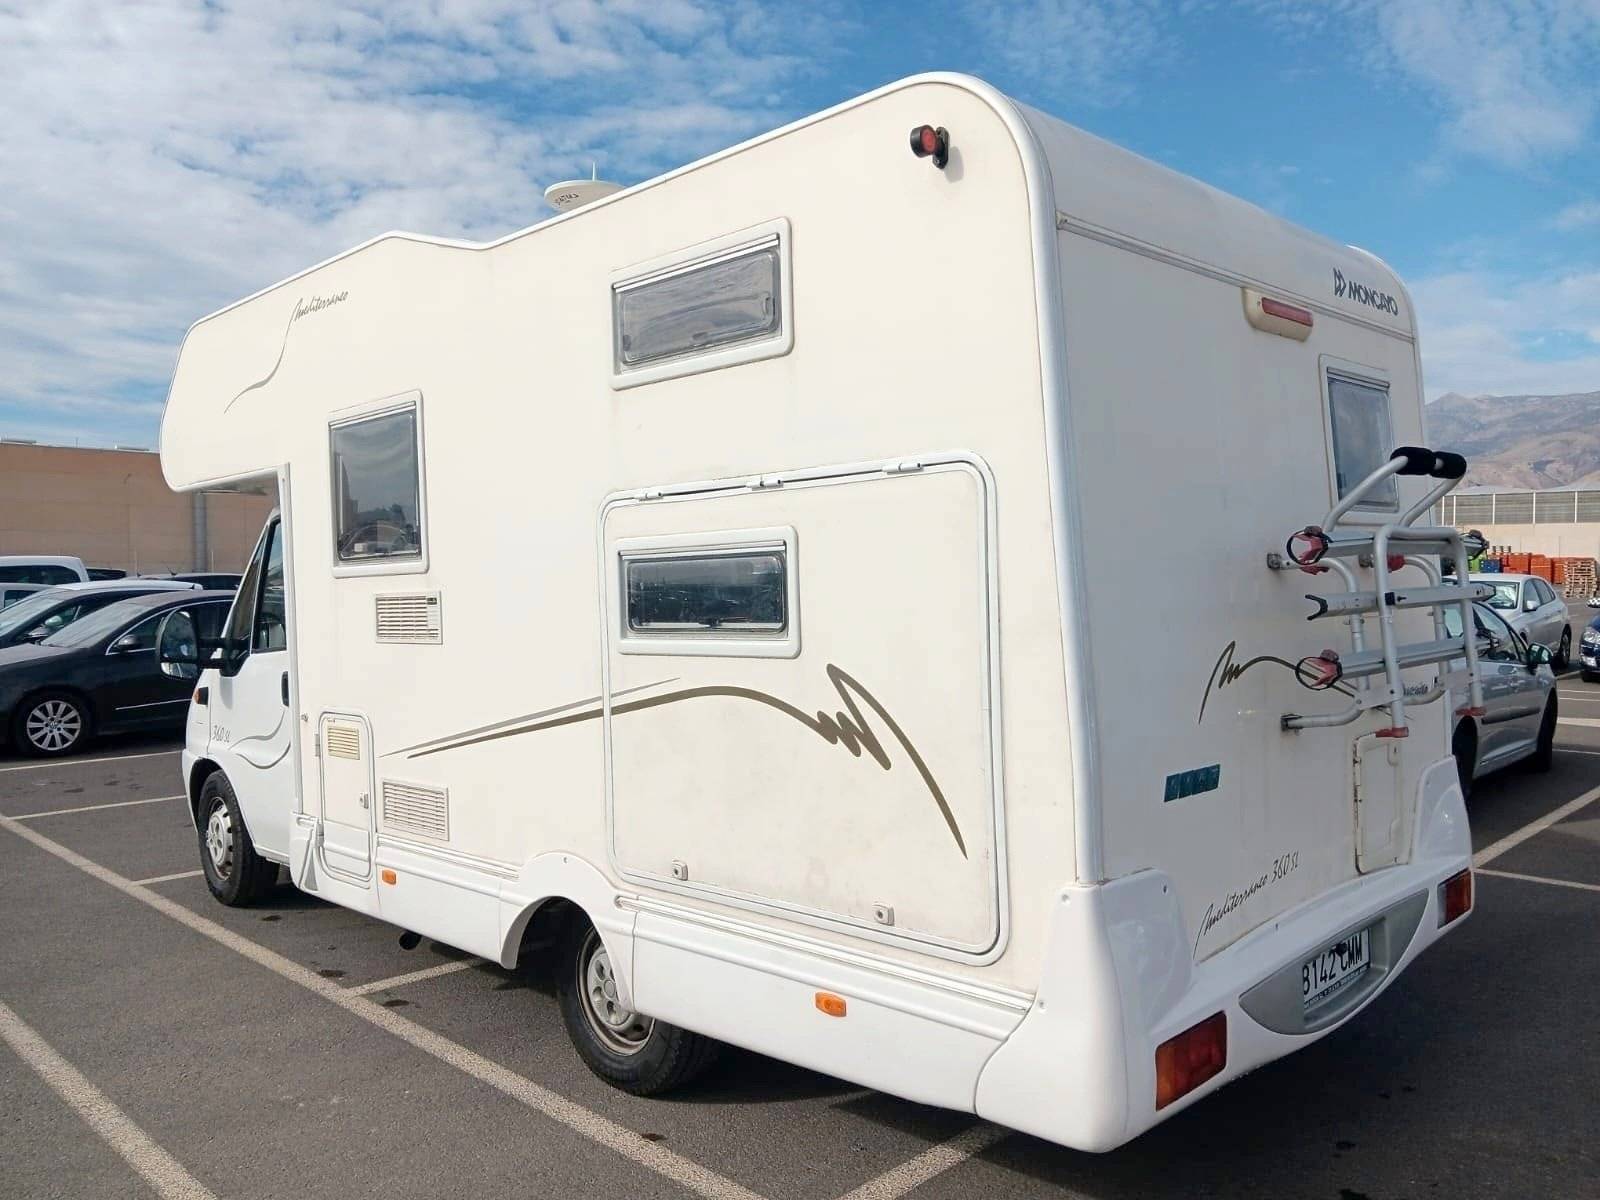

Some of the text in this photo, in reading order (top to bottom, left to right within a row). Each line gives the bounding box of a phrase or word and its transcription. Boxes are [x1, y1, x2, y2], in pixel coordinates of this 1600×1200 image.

[1348, 280, 1398, 316] MONCAYO
[1272, 853, 1290, 883] 360
[1302, 949, 1336, 995] 8142
